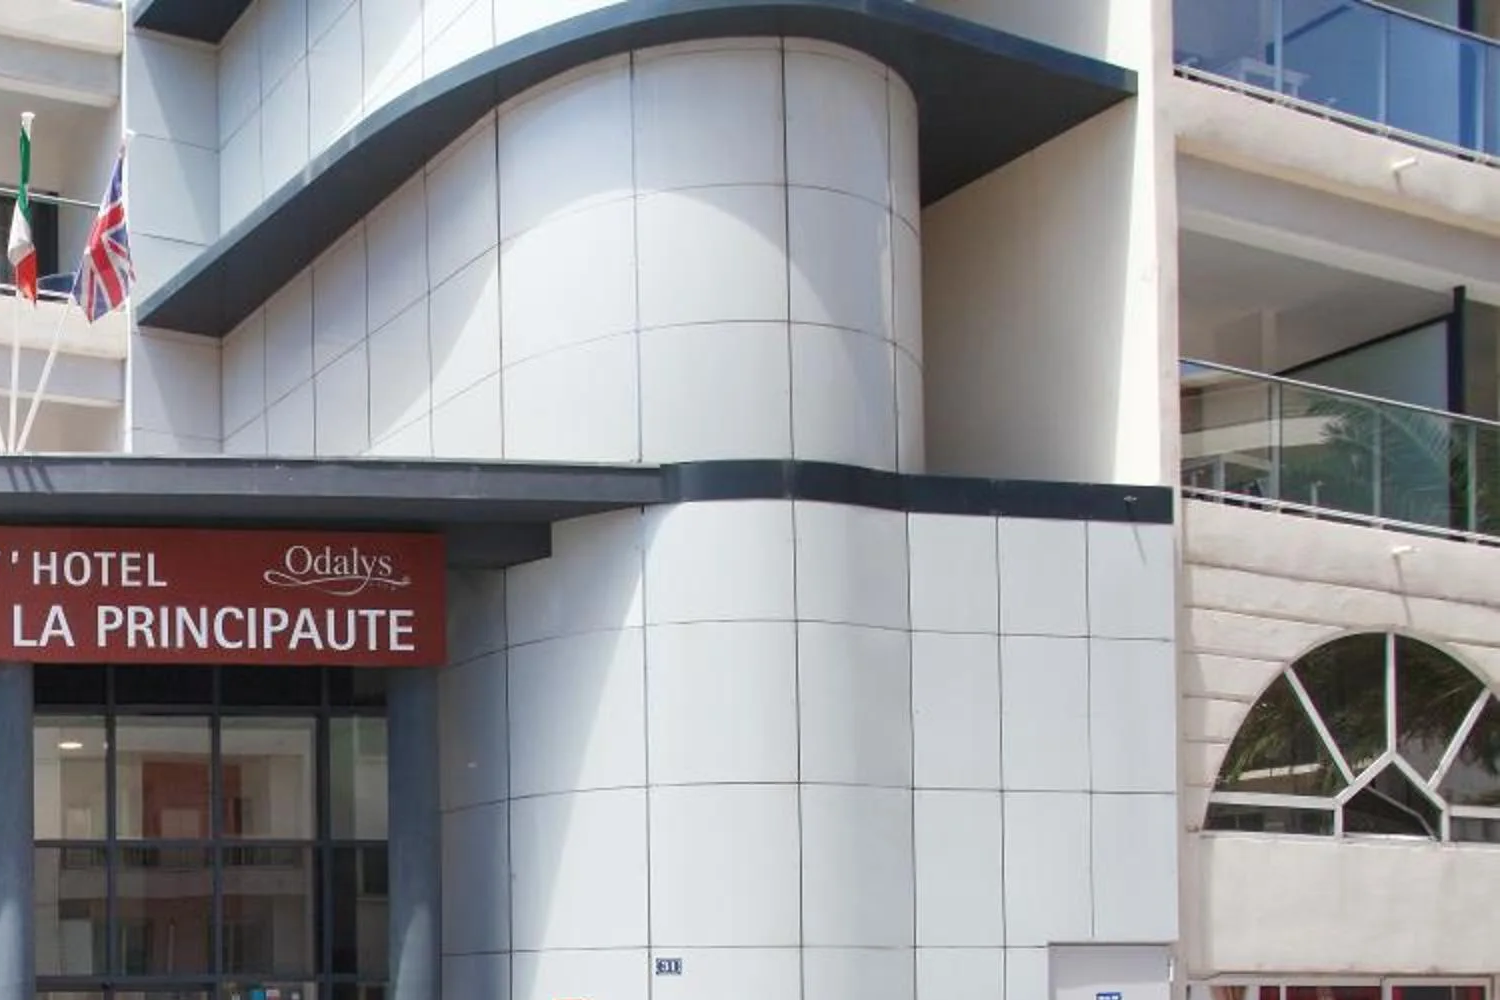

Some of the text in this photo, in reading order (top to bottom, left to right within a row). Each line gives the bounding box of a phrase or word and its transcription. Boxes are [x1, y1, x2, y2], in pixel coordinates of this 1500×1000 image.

[285, 545, 393, 581] Odalys
[13, 603, 76, 648] LA
[97, 605, 415, 651] PRINCIPAUTE
